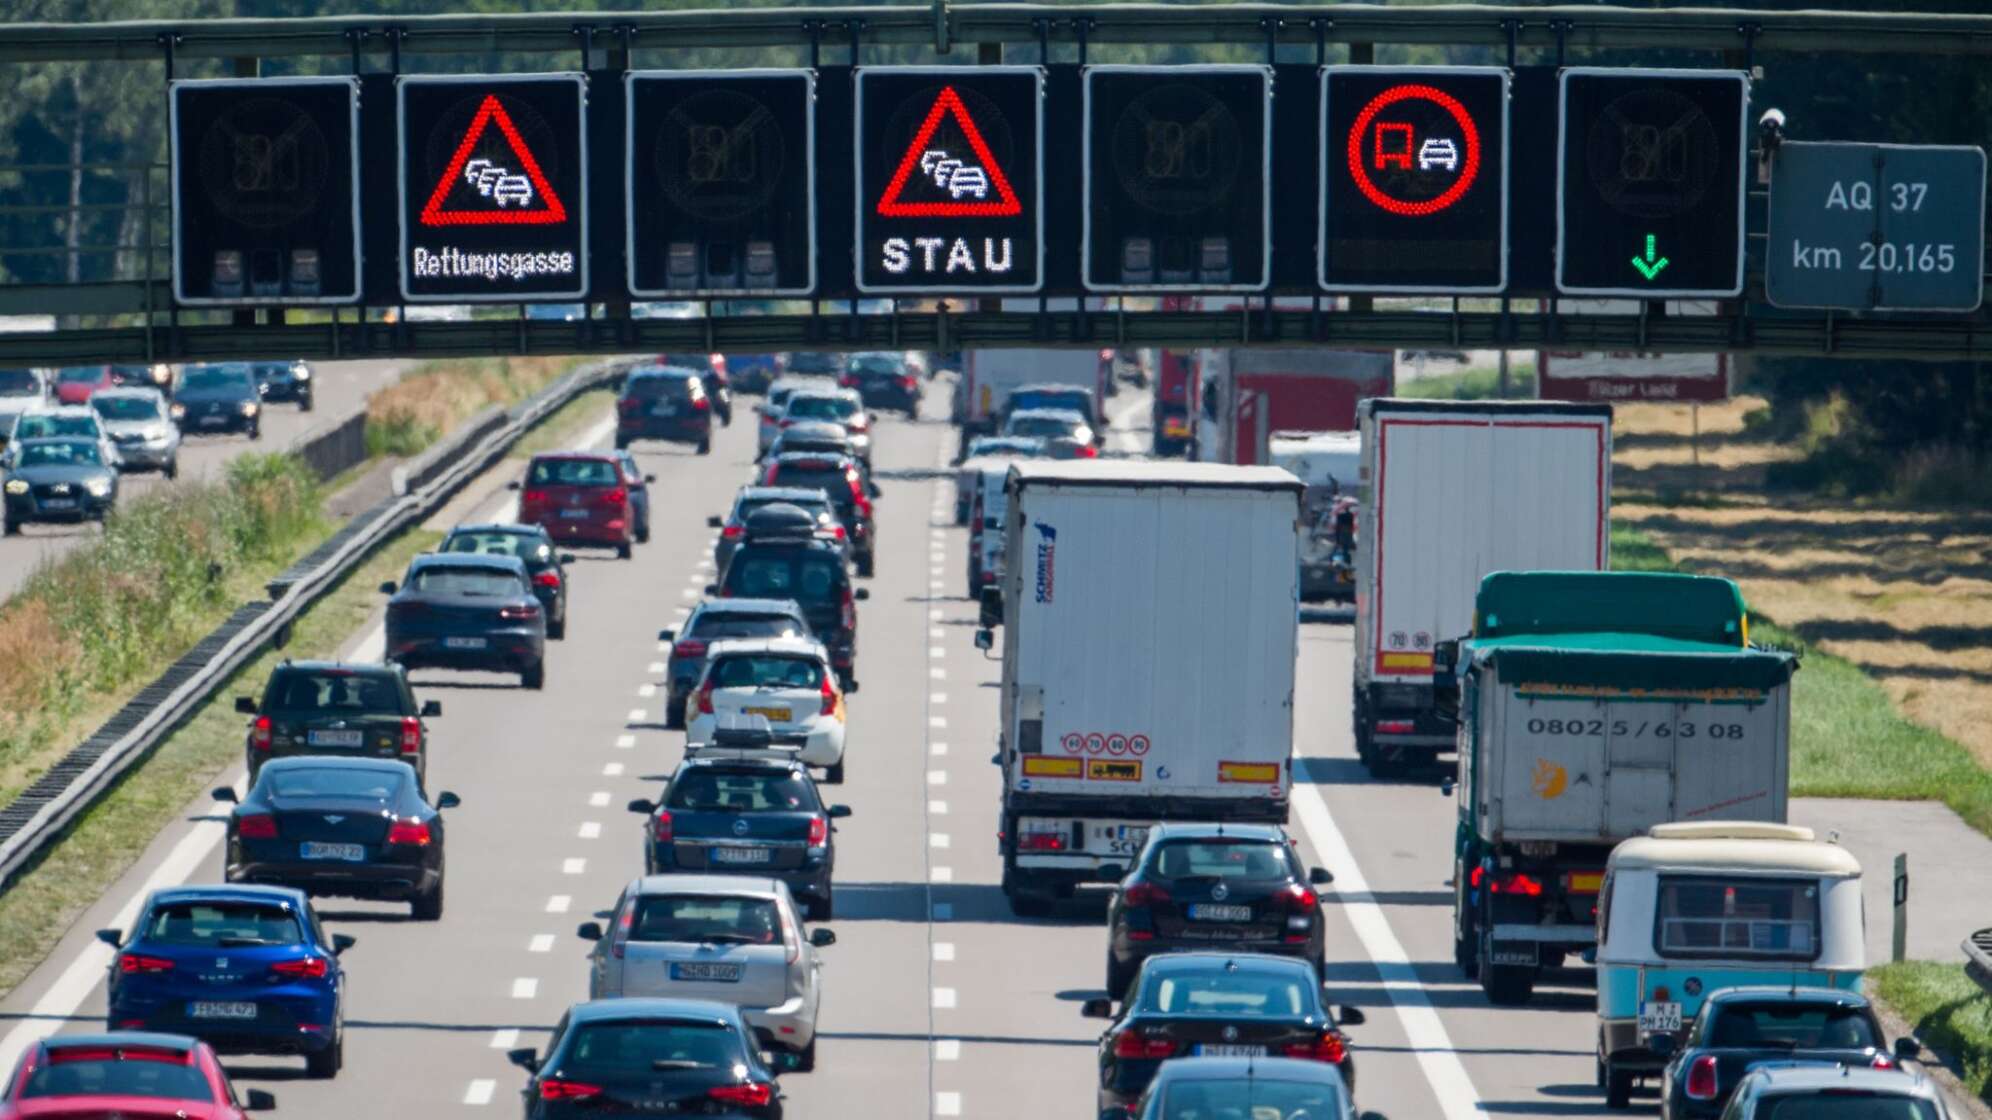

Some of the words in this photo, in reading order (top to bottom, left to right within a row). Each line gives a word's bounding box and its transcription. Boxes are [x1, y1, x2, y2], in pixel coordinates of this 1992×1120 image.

[1825, 181, 1873, 210] AQ
[1890, 182, 1929, 211] 37
[413, 246, 573, 280] Rettungsgasse
[882, 236, 1012, 272] STAU
[1792, 239, 1841, 269] km
[1858, 241, 1955, 273] 20,165
[1035, 543, 1047, 603] SCHMITZ
[1658, 1016, 1680, 1029] 176
